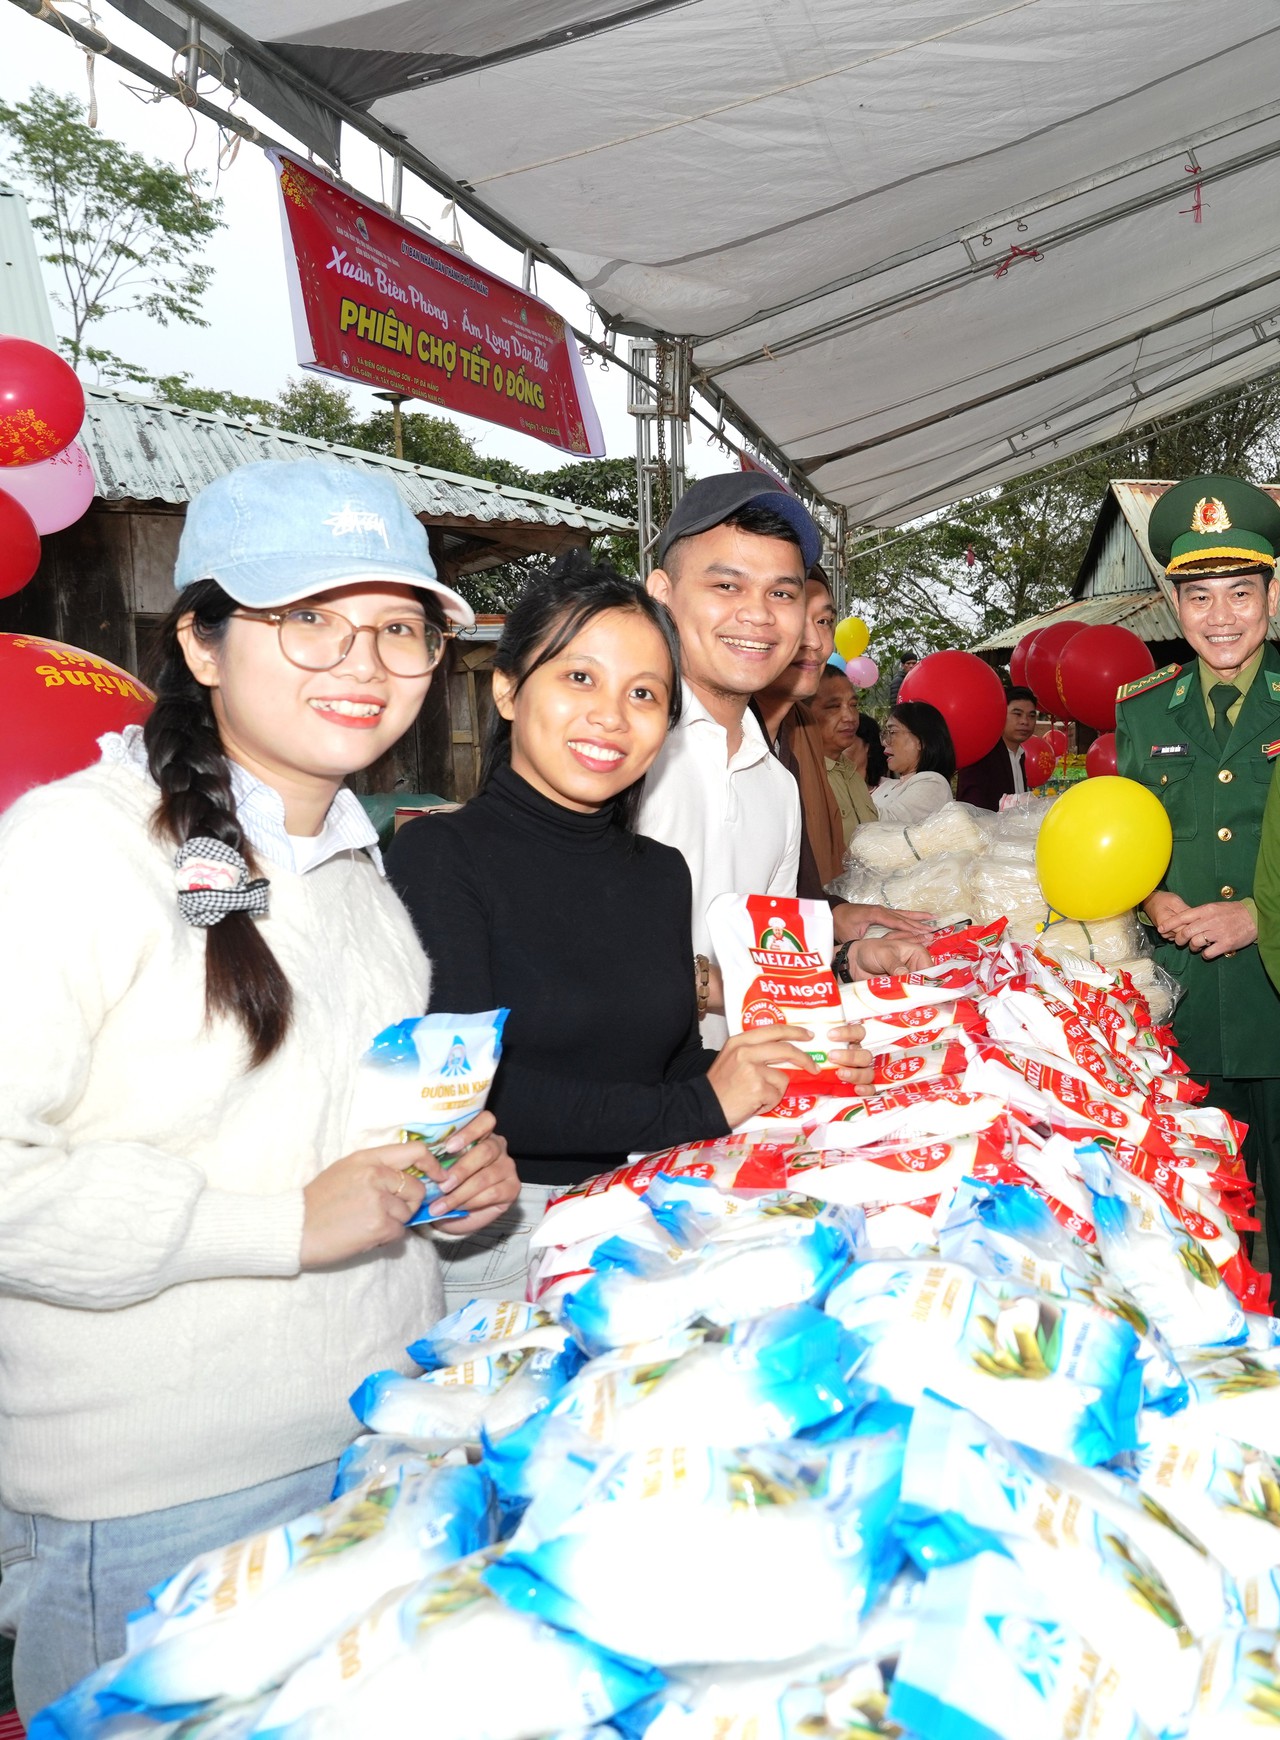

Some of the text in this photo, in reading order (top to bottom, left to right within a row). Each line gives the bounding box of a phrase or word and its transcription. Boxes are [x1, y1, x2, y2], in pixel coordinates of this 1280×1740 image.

[326, 246, 374, 287] Xuân
[374, 267, 408, 304] Biên
[408, 285, 449, 329] Phòng
[461, 306, 483, 340] Ấm
[485, 323, 510, 359] Lòng
[510, 335, 533, 363] Dân
[340, 297, 414, 356] PHIÊN
[417, 329, 457, 379] CHỢ
[460, 339, 490, 386] TẾT
[506, 364, 546, 410] ĐỒNG
[752, 951, 821, 968] MEIZAN
[760, 980, 833, 998] BỘT NGỌT
[744, 1003, 784, 1024] ĐỘ TINH KHIẾT
[755, 1016, 774, 1026] TRÊN
[458, 1084, 470, 1097] AN
